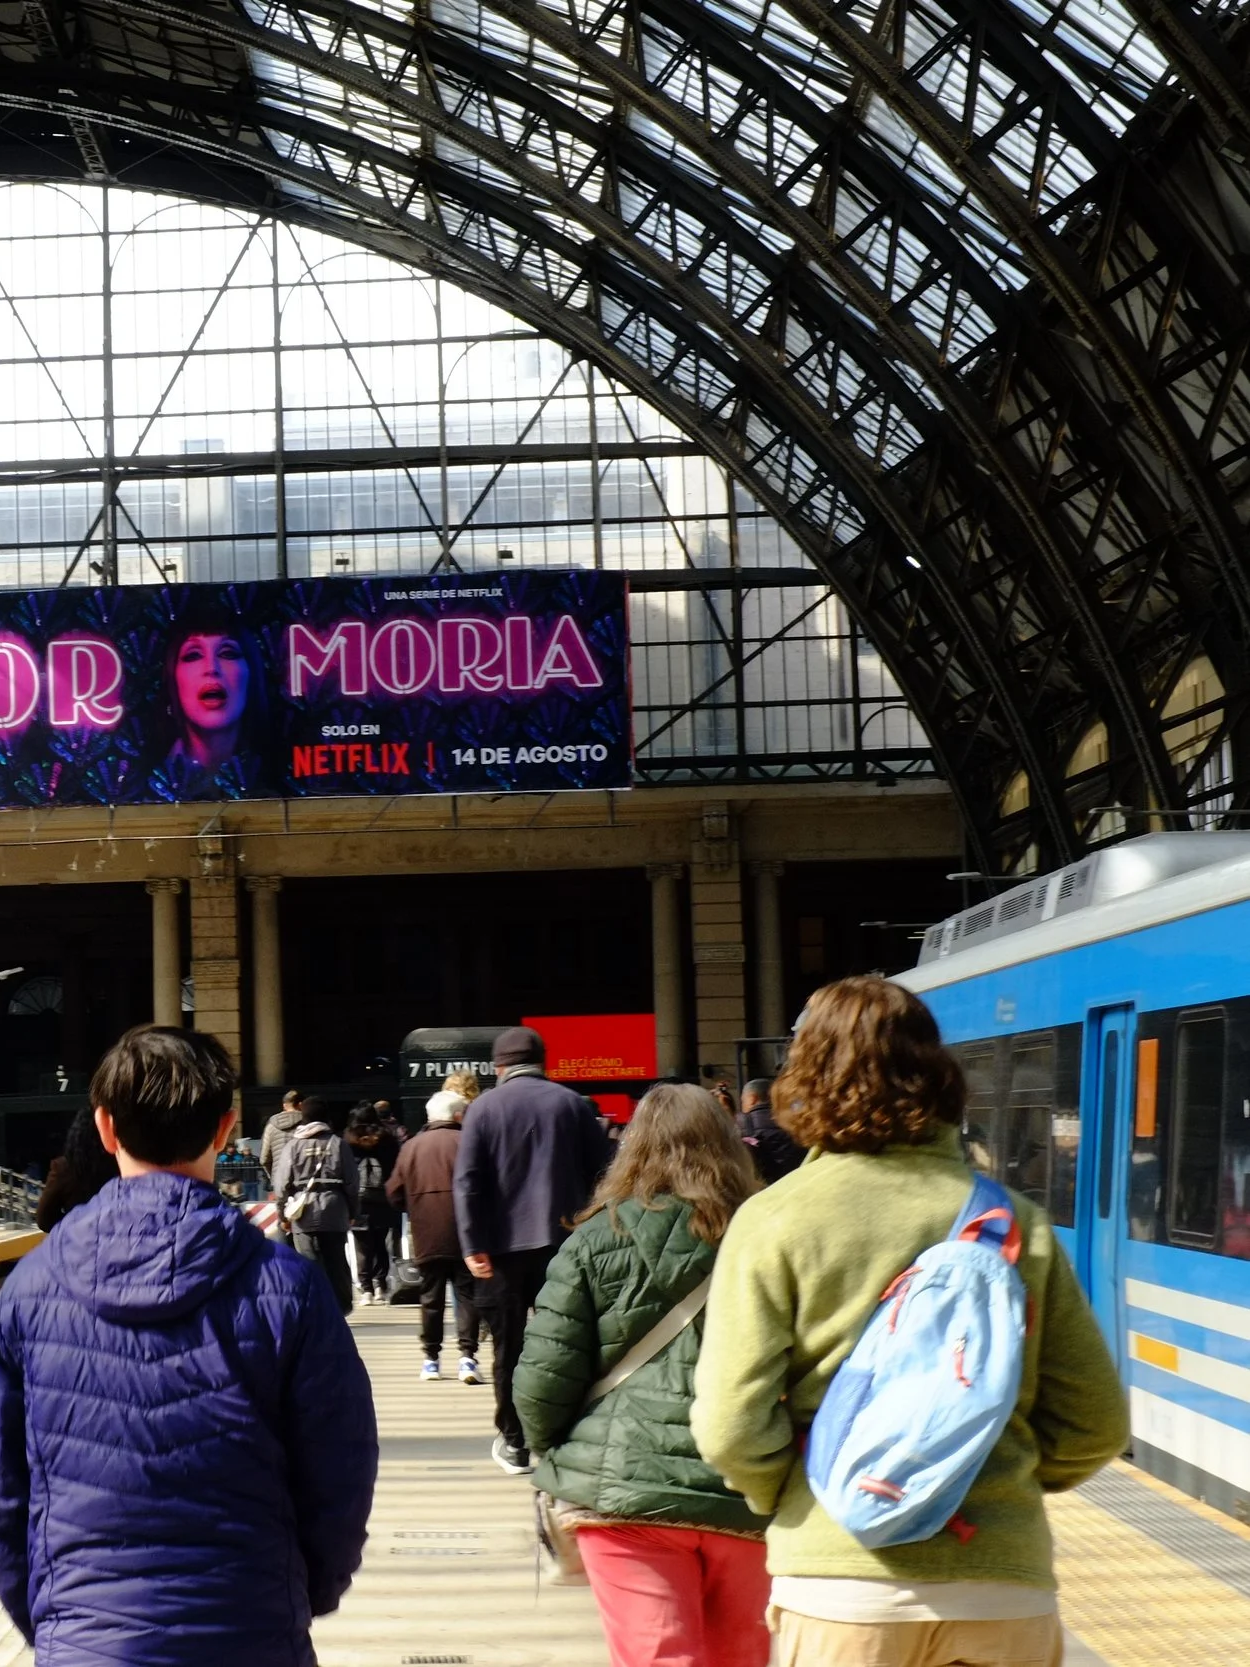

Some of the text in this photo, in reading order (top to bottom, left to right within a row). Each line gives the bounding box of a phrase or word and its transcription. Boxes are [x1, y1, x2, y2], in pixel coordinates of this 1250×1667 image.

[383, 588, 503, 600] UNA SERIE DE NETFLIX
[289, 615, 603, 696] MORIA
[321, 724, 381, 736] SOLO EN
[293, 742, 410, 778] NETFLIX
[451, 744, 608, 765] 14 DE AGOSTO
[408, 1063, 421, 1077] 7
[579, 1066, 647, 1077] CONECTARTE
[57, 1078, 69, 1091] 7
